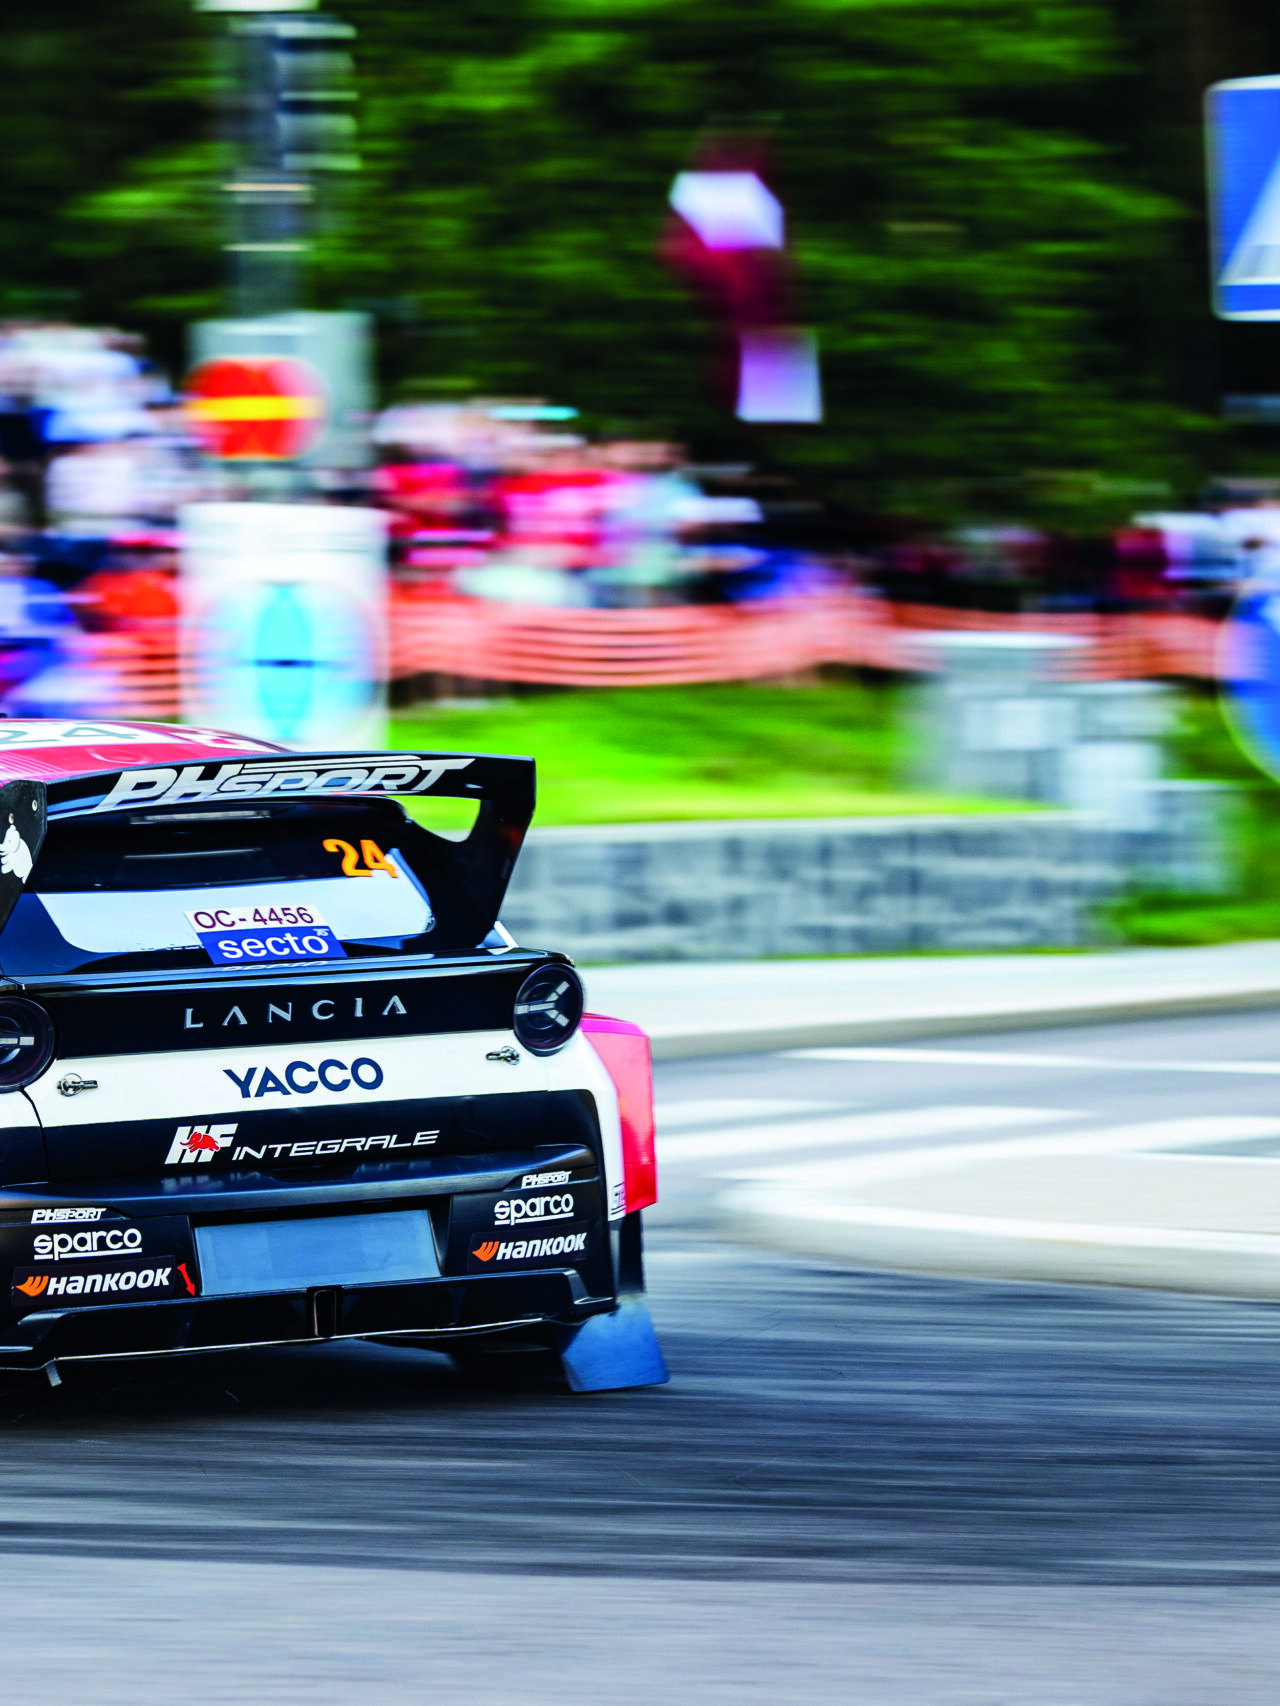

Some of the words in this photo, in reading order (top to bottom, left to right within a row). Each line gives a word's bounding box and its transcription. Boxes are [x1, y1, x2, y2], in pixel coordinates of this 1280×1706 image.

[323, 839, 399, 877] 24
[218, 933, 329, 959] secto
[184, 995, 408, 1030] LANCIA
[222, 1057, 384, 1099] YACCO
[232, 1130, 440, 1161] INTEGRALE
[494, 1194, 574, 1226] sparco
[34, 1228, 142, 1261] sparco
